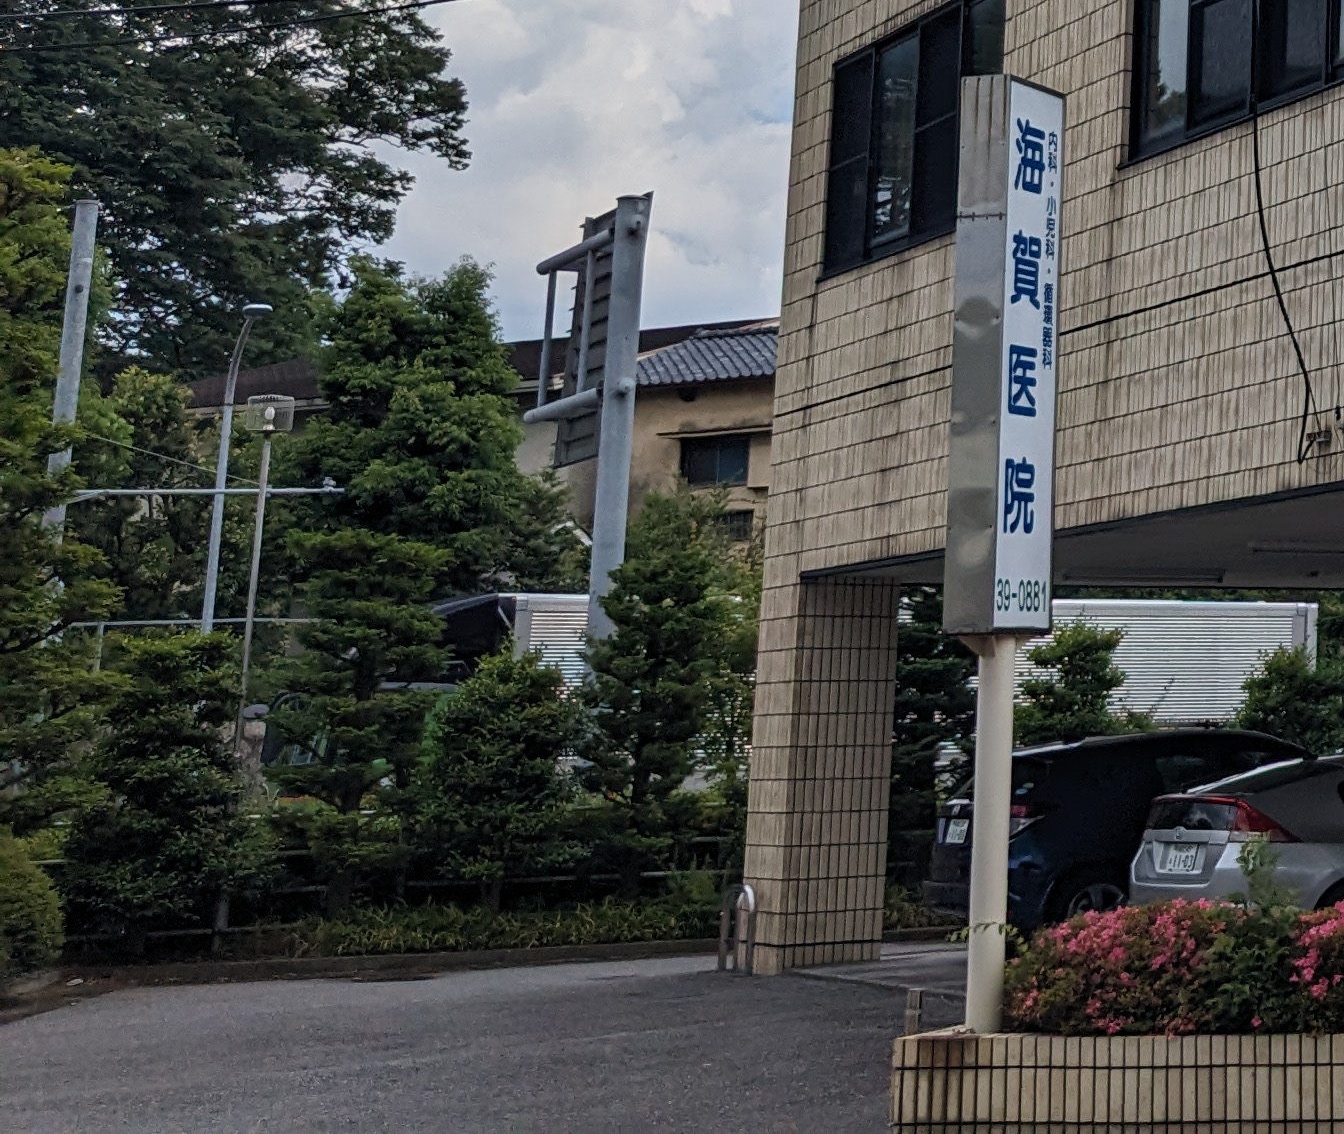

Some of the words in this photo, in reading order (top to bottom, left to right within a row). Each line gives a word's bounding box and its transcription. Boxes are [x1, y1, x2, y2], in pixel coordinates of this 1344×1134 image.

[1003, 117, 1046, 535] 海賀医院
[996, 577, 1047, 612] 39-0881
